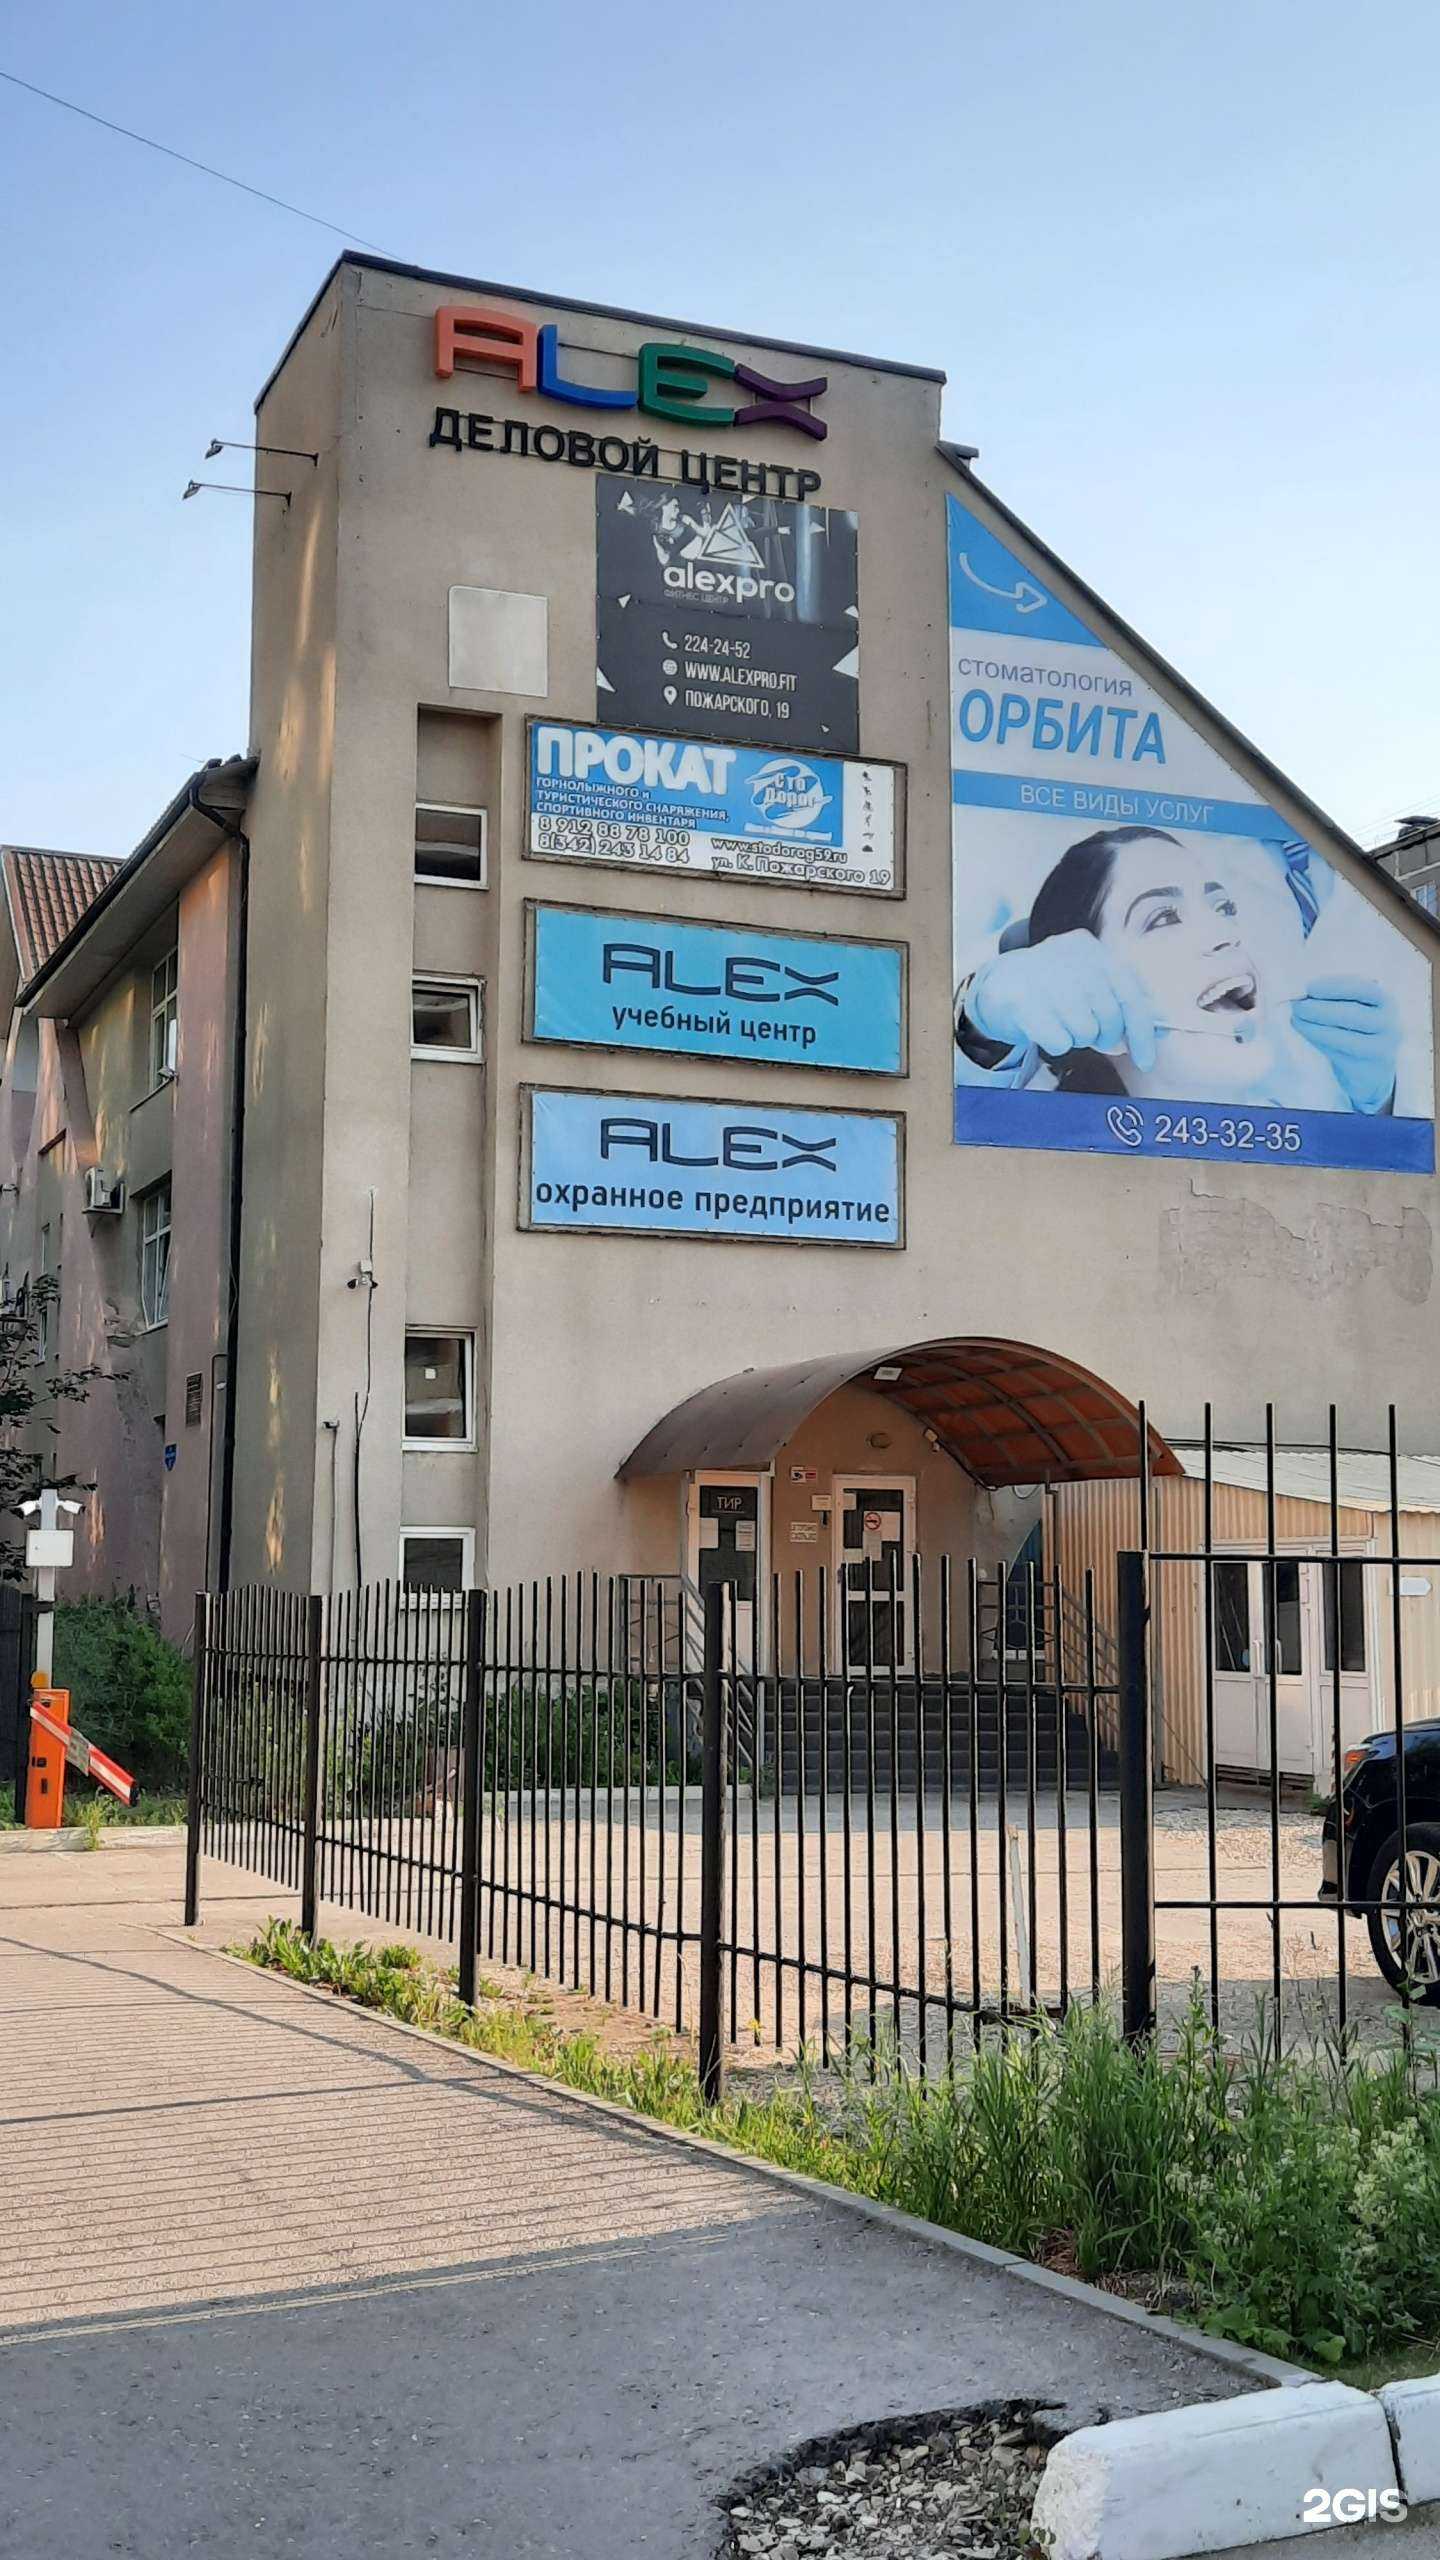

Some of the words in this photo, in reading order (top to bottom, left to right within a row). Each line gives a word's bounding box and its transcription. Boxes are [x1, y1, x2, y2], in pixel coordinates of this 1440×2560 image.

[435, 306, 828, 441] ALEX
[429, 406, 659, 478] ДЕЛОВОЙ
[681, 448, 821, 500] ЦЕНТР
[664, 562, 795, 603] alexpro
[684, 634, 751, 659] 224-24-52
[684, 661, 797, 691] WWW.ALEXPRO.FIT
[957, 656, 1132, 697] стоматология
[685, 689, 772, 718] ПОЖАРСКОГО,
[776, 701, 790, 719] 19
[958, 688, 1166, 764] ОРБИТА
[537, 726, 736, 795] ПРОКАТ
[536, 777, 640, 798] ГОРНОЛЫЖНОГО
[537, 790, 642, 811] ТУРИСТИЧЕСКОГО
[646, 803, 730, 822] СНАРЯЖЕНИЯ,
[1019, 783, 1065, 808] ВСЕ
[1073, 789, 1139, 818] ВИДЫ
[1145, 798, 1214, 824] УСЛУГ
[536, 802, 625, 821] СПОРТИВНОГО
[627, 812, 697, 829] ИНВЕНТАРЯ
[539, 816, 551, 831] 8
[556, 818, 592, 835] 912
[597, 822, 621, 839] 88
[625, 826, 649, 841] 78
[656, 829, 690, 846] 100
[539, 832, 596, 855] 8(342)
[599, 840, 635, 858] 243
[639, 844, 662, 860] 14
[666, 847, 690, 864] 84
[711, 838, 847, 863] www.stodorog59.ru
[711, 856, 733, 870] ул.
[736, 854, 754, 871] К.
[756, 857, 865, 882] Пожарского
[869, 869, 890, 885] 19
[603, 943, 839, 1006] ALEX
[612, 1005, 731, 1036] учебный
[740, 1014, 817, 1049] центр
[601, 1117, 837, 1172] ALEX
[1154, 1115, 1301, 1152] 243-32-35
[536, 1182, 684, 1212] охранное
[695, 1190, 890, 1224] предприятие
[717, 1496, 742, 1510] ТИР
